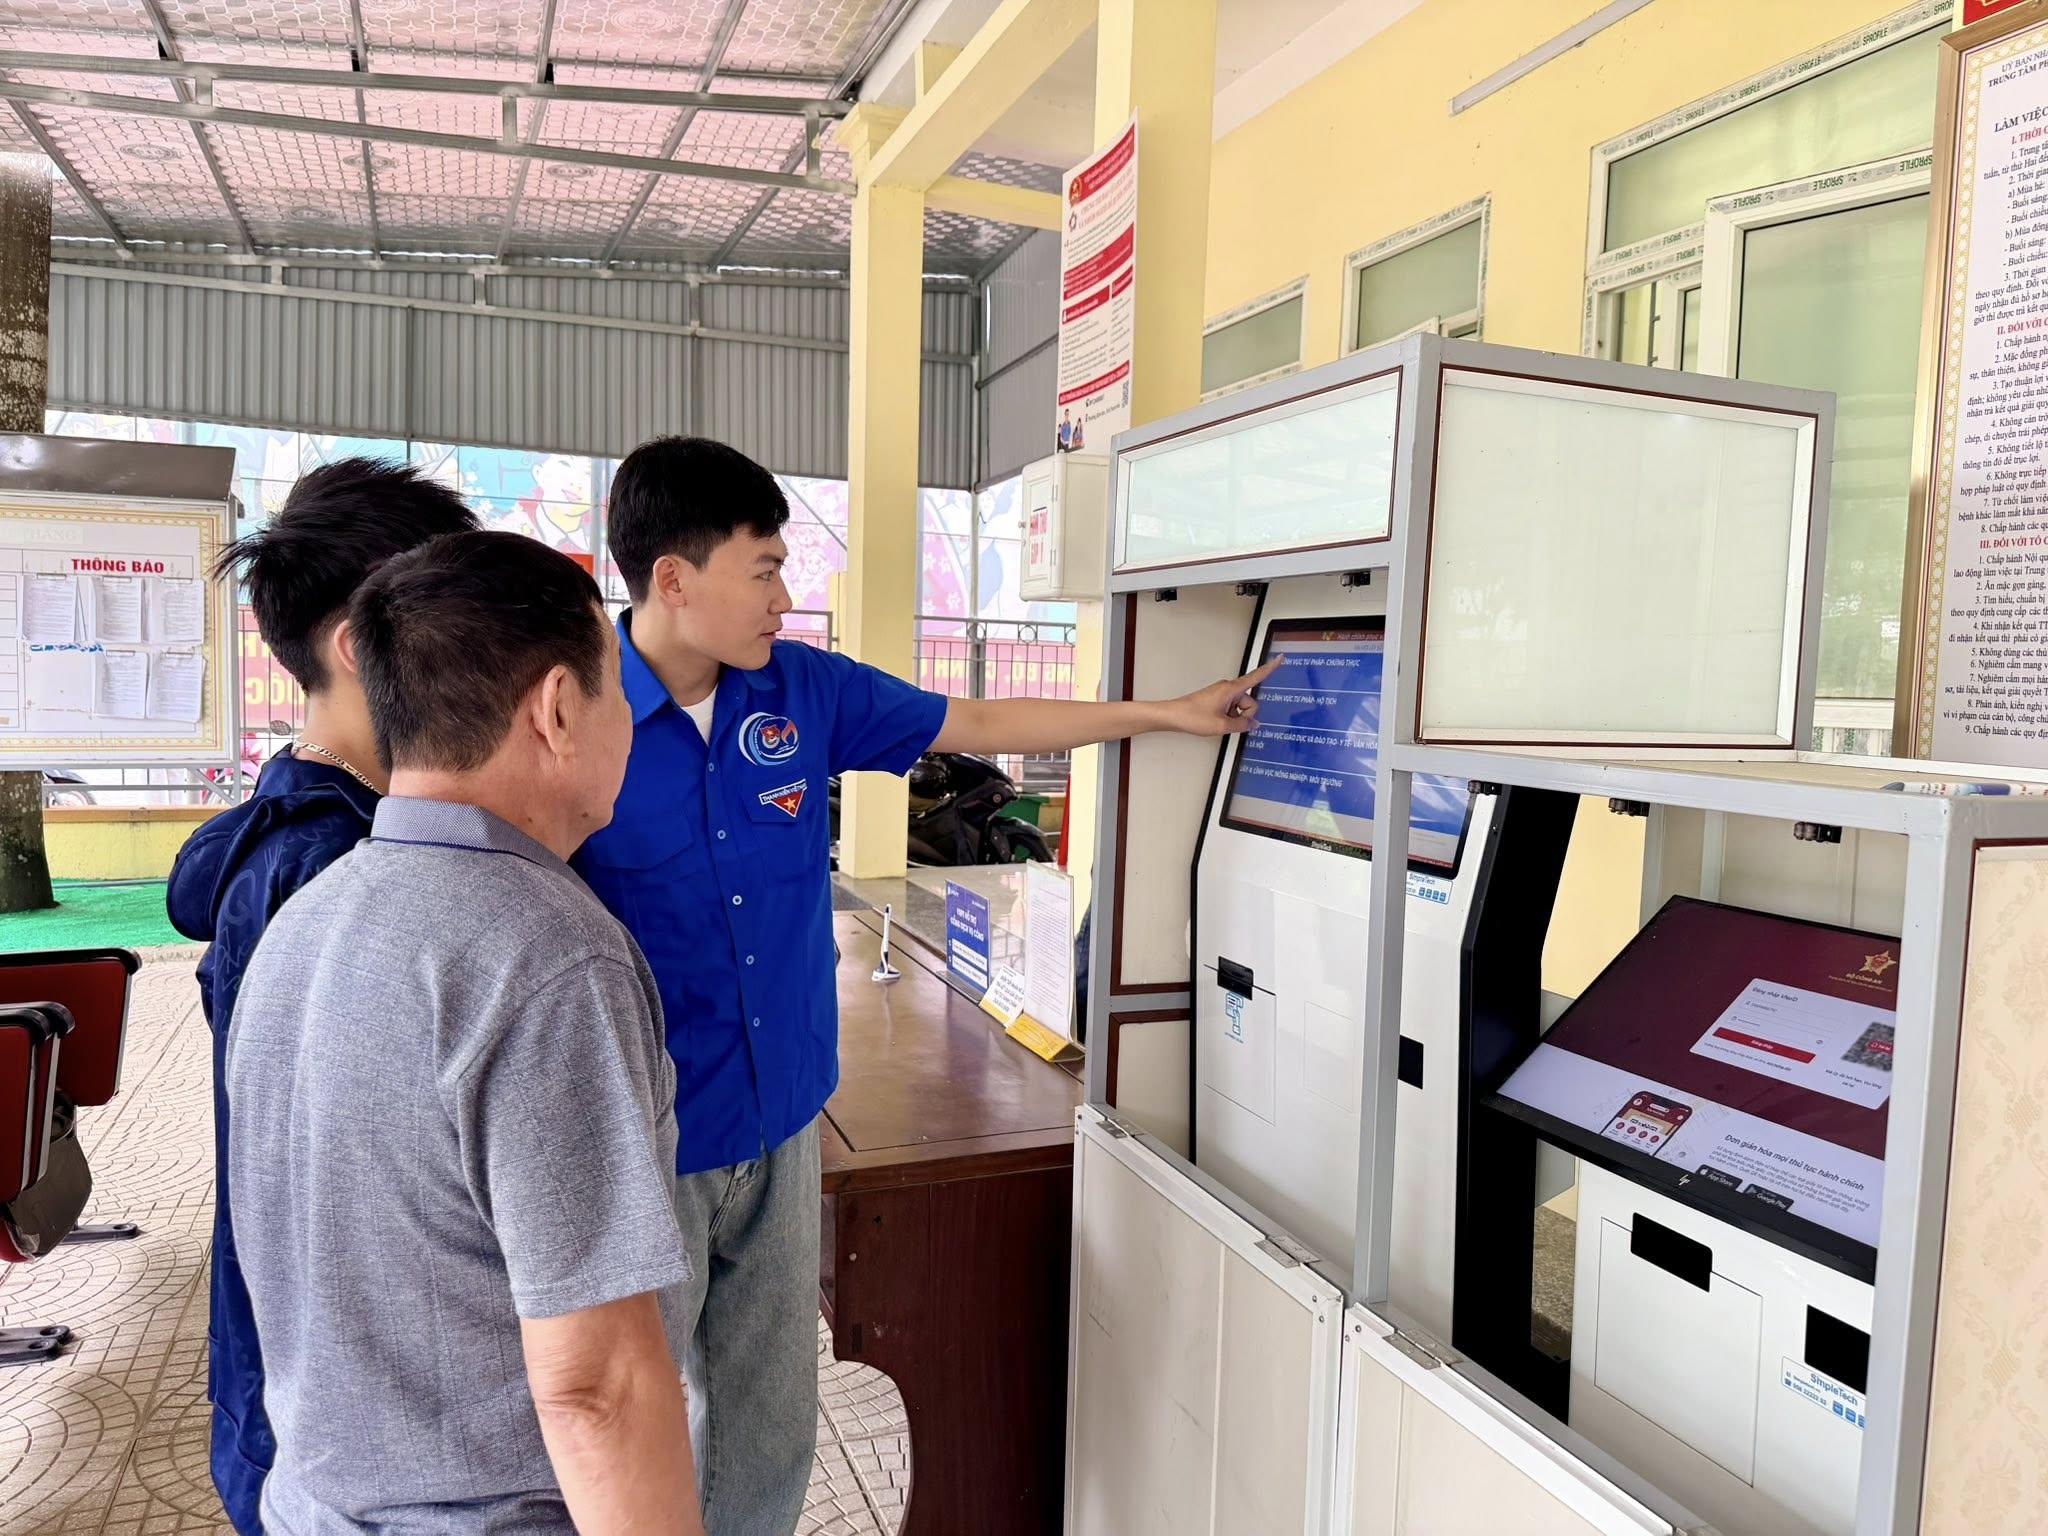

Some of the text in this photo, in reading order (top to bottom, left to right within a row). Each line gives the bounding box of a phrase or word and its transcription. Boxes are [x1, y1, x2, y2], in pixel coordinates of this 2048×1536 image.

[1862, 28, 1888, 46] SPROFILE
[1798, 56, 1820, 73] SPROFILE
[1988, 72, 2016, 88] TRUNG
[1900, 155, 1932, 172] SPROFILE
[1813, 175, 1844, 190] SPROFILE
[71, 557, 164, 574] THÔNG BÁO
[1774, 1150, 1789, 1164] mọi
[1818, 1166, 1840, 1182] hành
[1840, 1174, 1864, 1192] chính
[1810, 1373, 1858, 1406] SimpleTech
